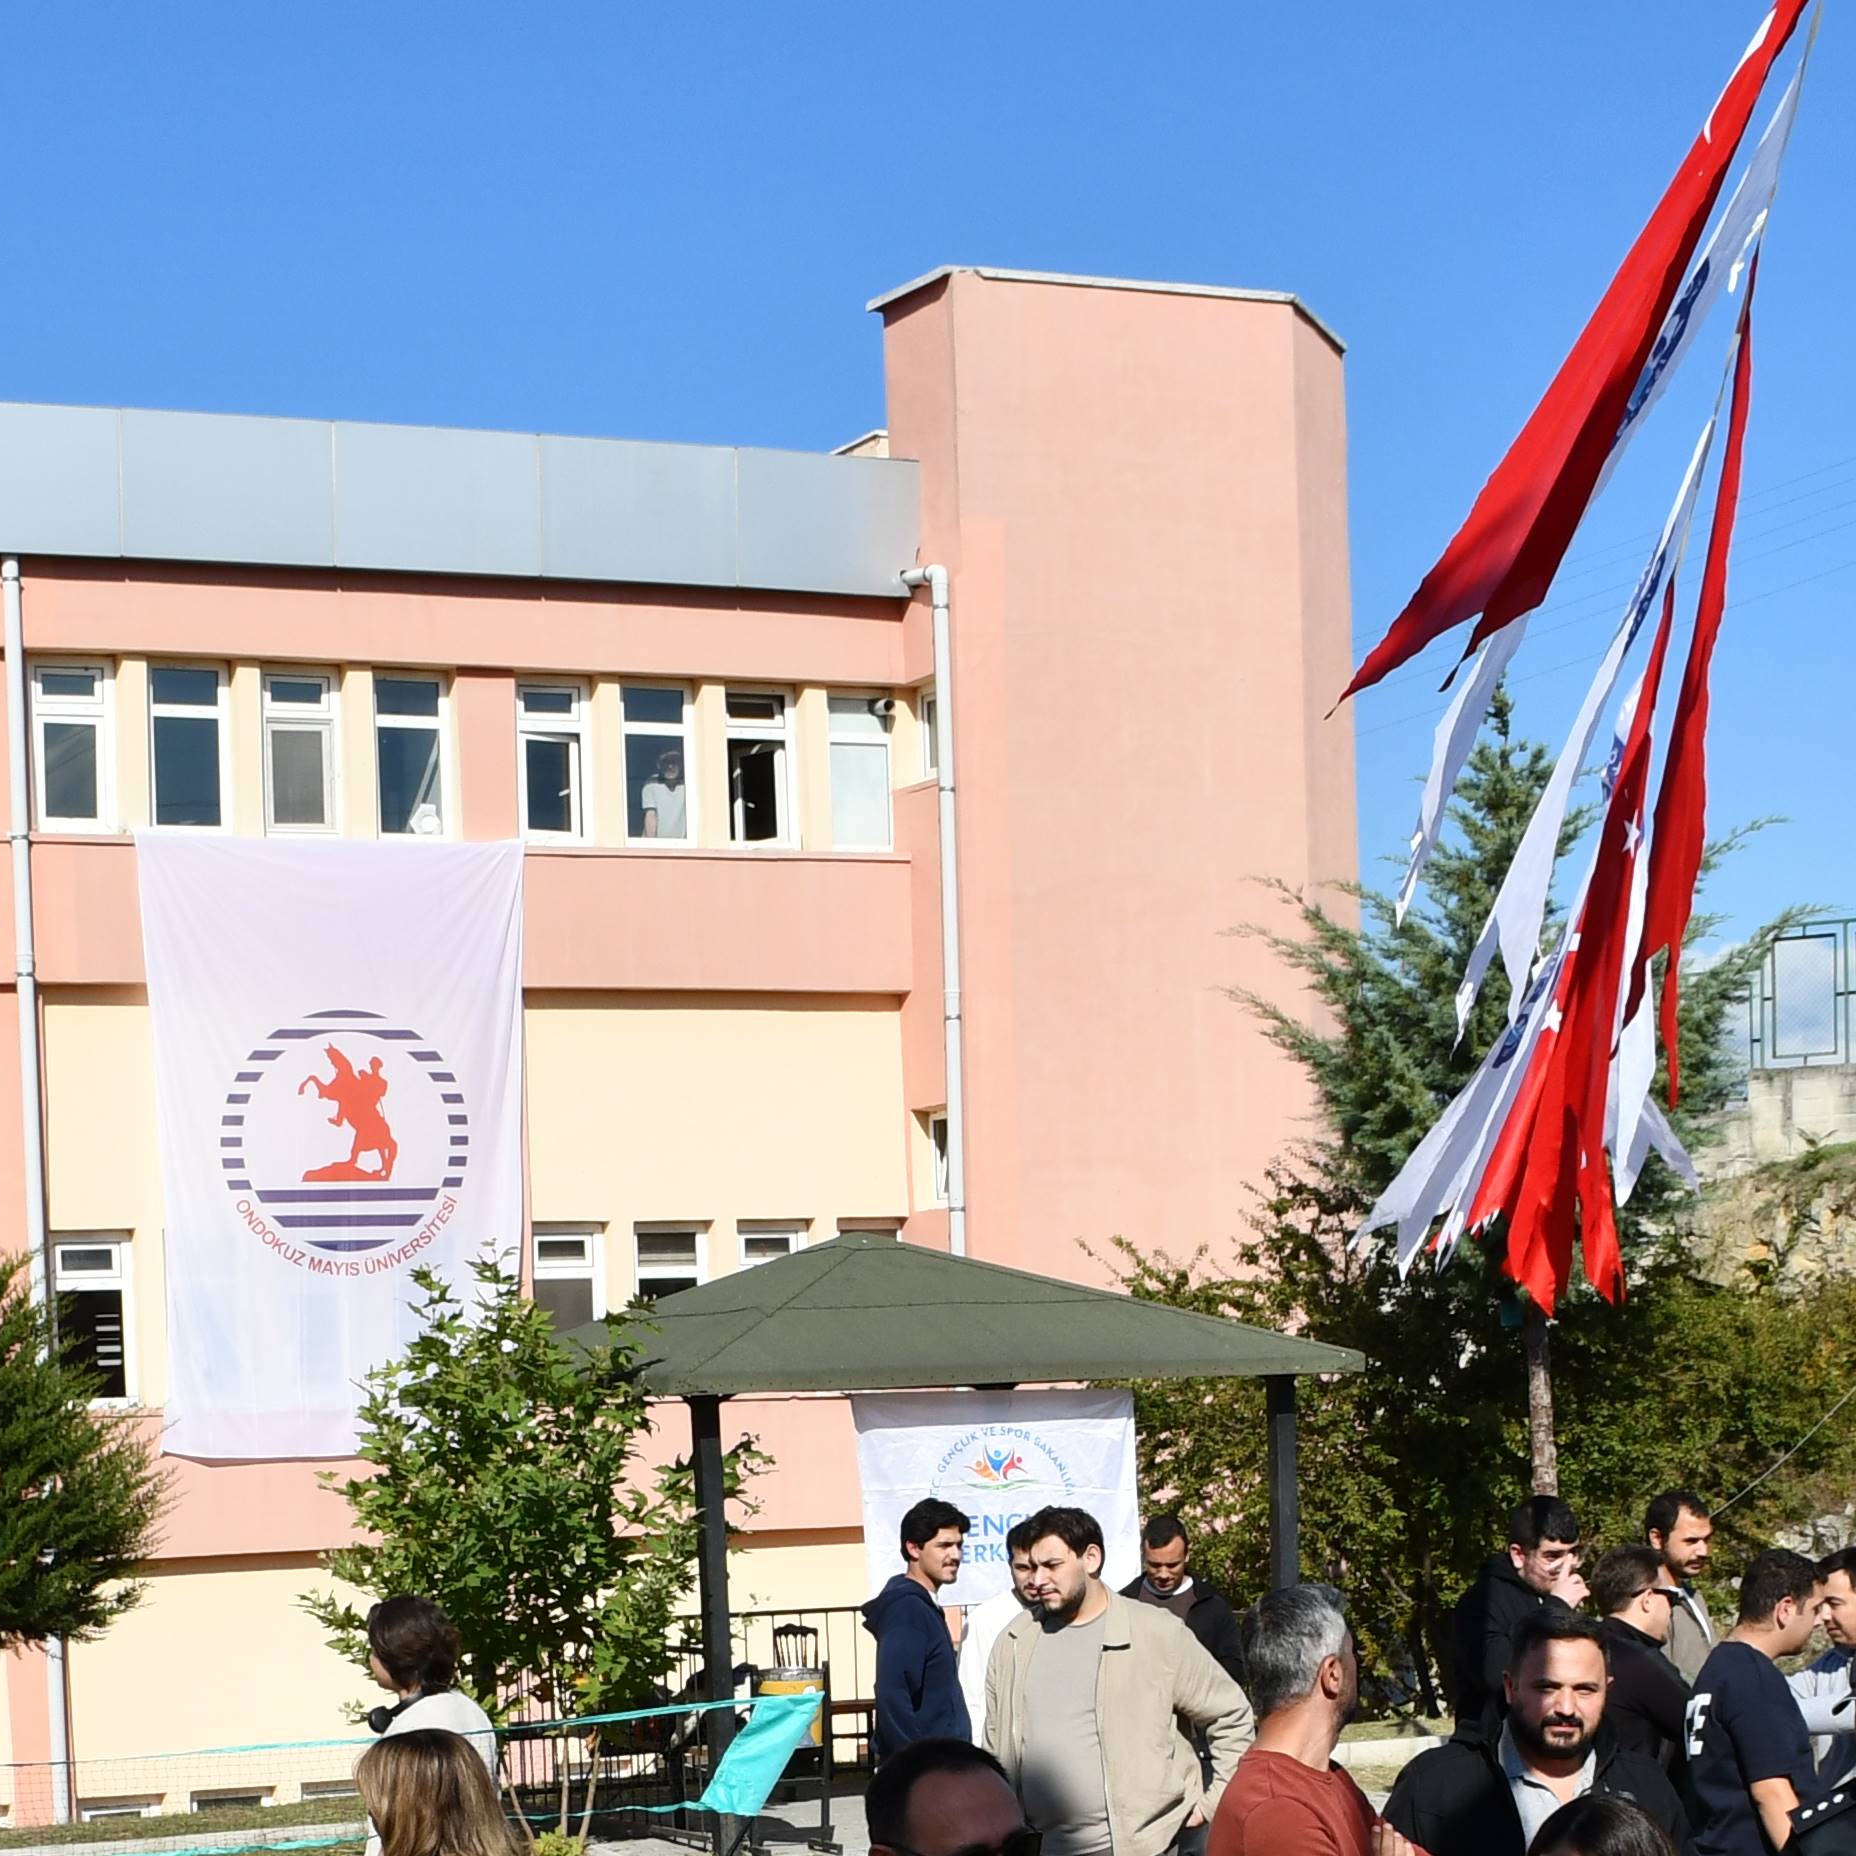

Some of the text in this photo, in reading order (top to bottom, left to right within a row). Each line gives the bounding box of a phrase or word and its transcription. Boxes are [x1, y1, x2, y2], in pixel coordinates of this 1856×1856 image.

[235, 1194, 458, 1277] ONDOKUZ MAYIS ÜNİVERSİTESİ
[981, 1426, 997, 1436] VE
[1000, 1426, 1031, 1441] SPOR
